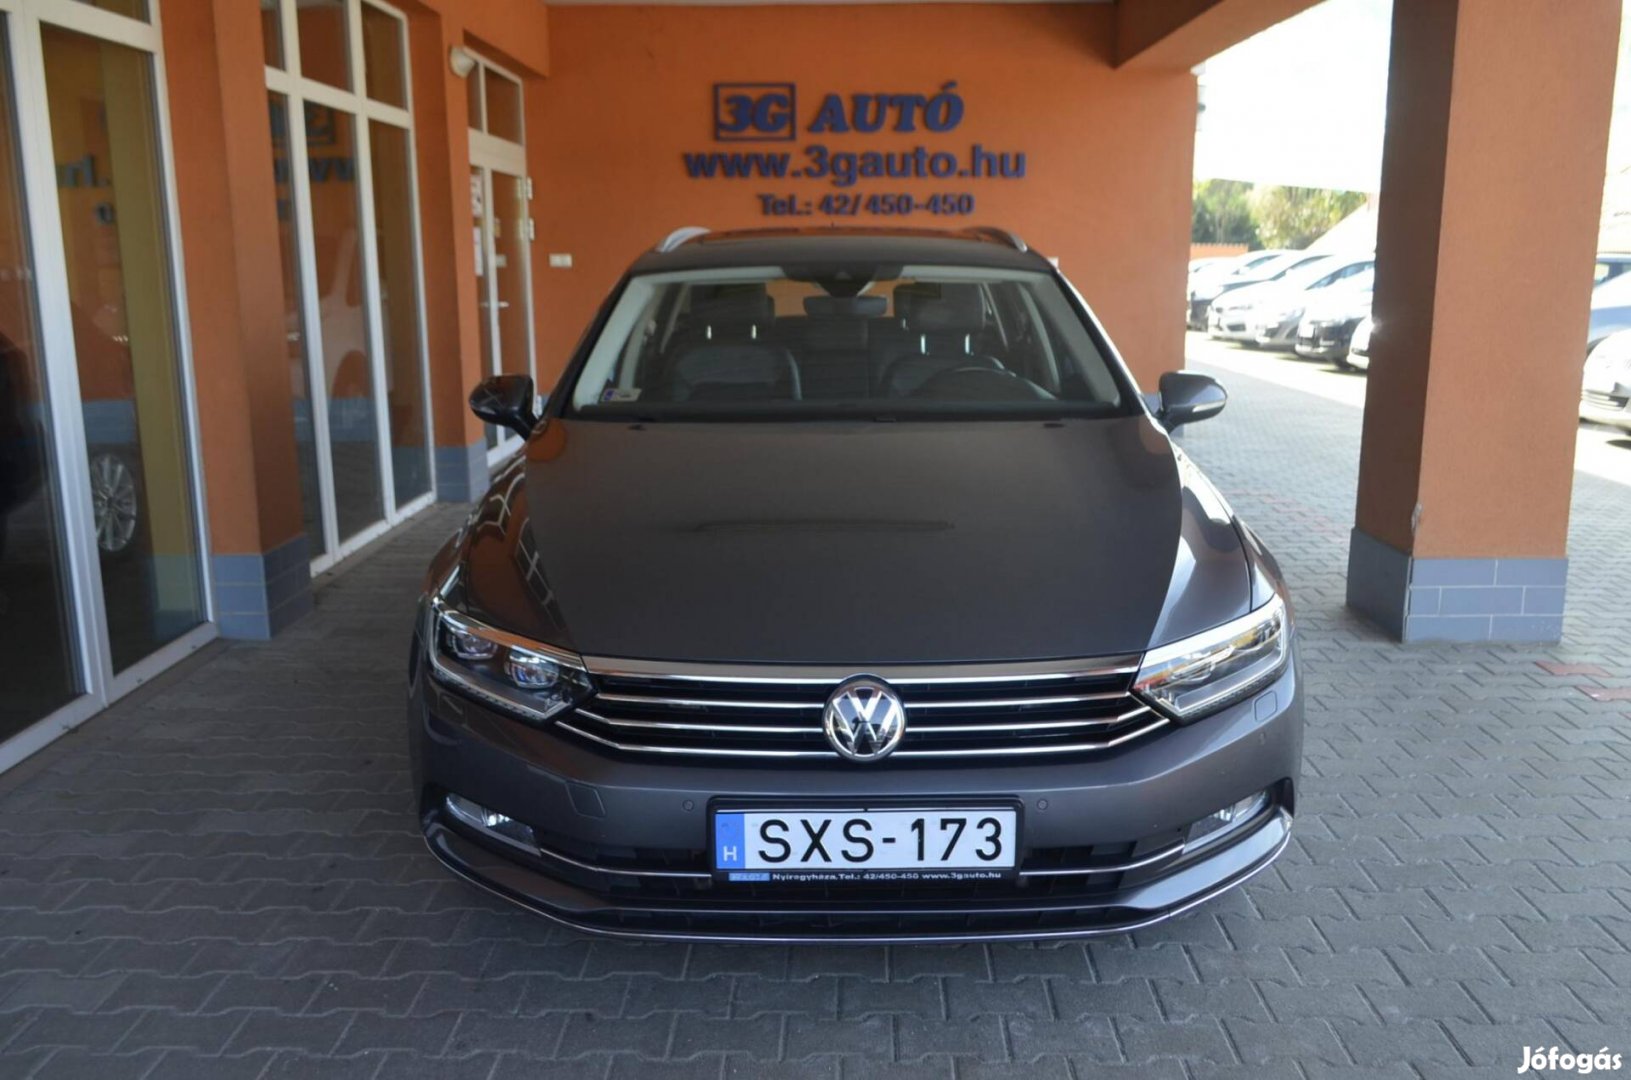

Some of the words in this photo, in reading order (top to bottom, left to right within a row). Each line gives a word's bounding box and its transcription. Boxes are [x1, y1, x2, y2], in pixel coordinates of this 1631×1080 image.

[719, 93, 790, 133] 3G
[808, 81, 964, 133] AUTÓ
[684, 144, 1026, 187] www.3gauto.hu
[723, 846, 737, 861] H
[758, 817, 1003, 863] SXS-173
[922, 872, 1002, 880] www.3gauto.hu
